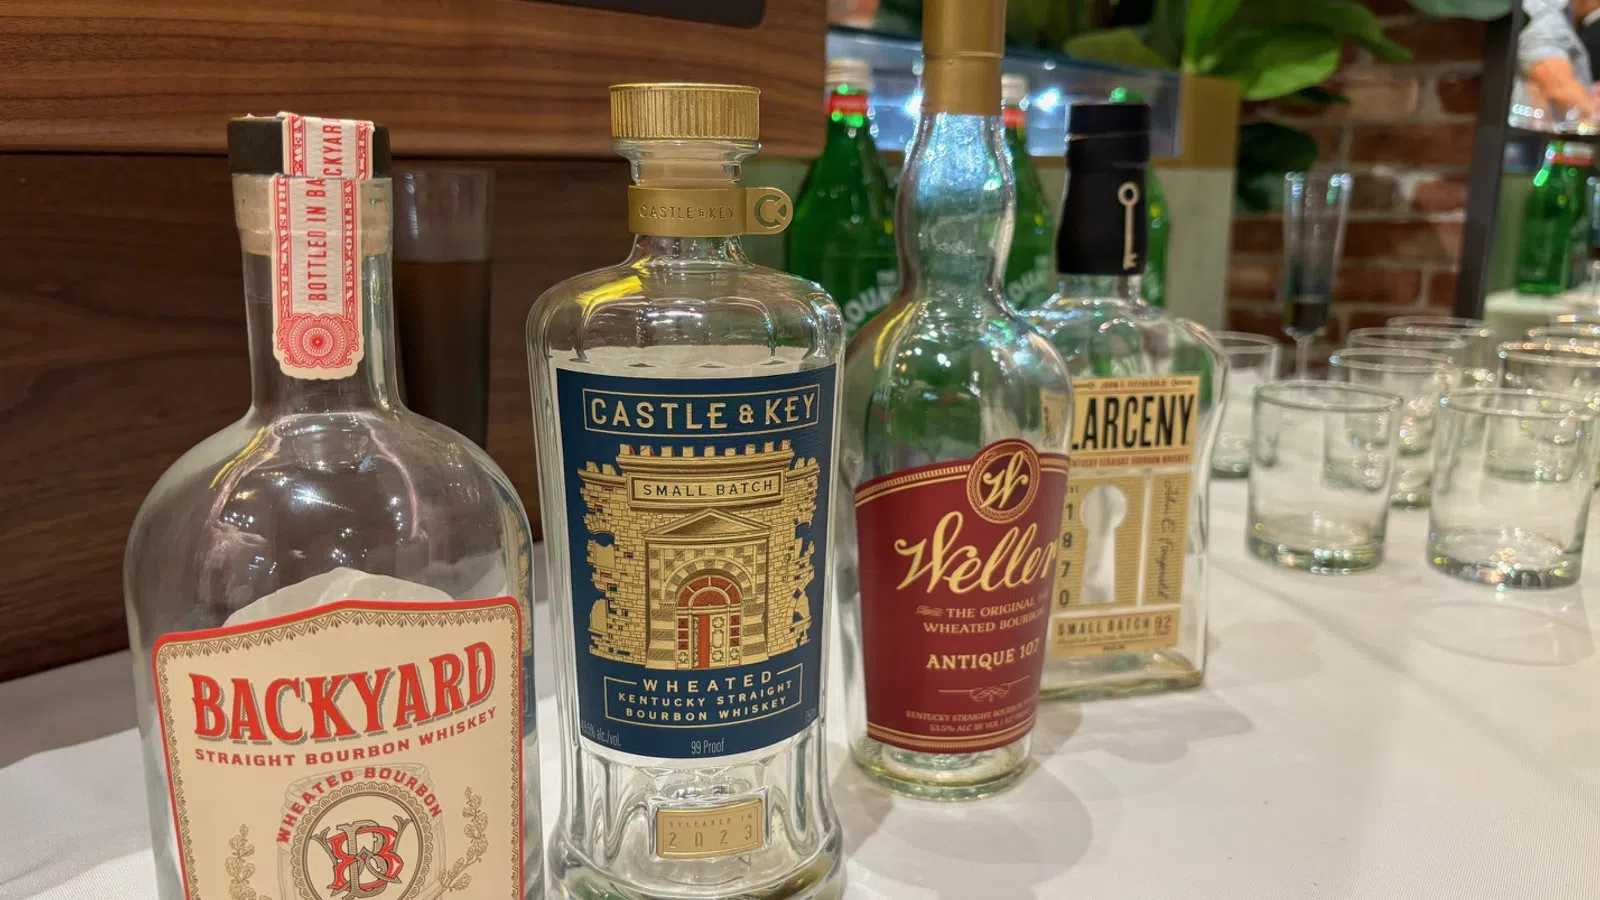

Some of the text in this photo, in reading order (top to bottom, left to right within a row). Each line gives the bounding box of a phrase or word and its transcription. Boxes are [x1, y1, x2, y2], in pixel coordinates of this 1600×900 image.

[306, 206, 327, 222] IN
[638, 205, 735, 219] CASTLE & KEY
[307, 230, 328, 301] BOTTLED
[591, 393, 815, 430] CASTLE & KEY
[1072, 394, 1194, 450] ARCENY
[643, 479, 773, 497] SMALL BATCH
[979, 451, 1029, 509] W
[894, 511, 1059, 594] Weller
[923, 606, 1046, 634] WHEATED BOURBON
[945, 597, 1036, 618] THE ORIGINAL
[1154, 613, 1172, 629] 92
[1057, 615, 1149, 637] SMALL BATCH
[926, 647, 1015, 671] ANTIQUE
[1019, 637, 1041, 659] 107
[188, 641, 497, 746] BACKYARD
[618, 679, 793, 707] KENTUCKY STRAIGHT
[642, 671, 772, 693] WHEATED
[625, 707, 707, 721] BOURBON
[718, 695, 787, 720] WHISKEY
[195, 706, 498, 767] STRAIGHT BOURBON WHISKEY
[691, 737, 725, 755] 99 Proof
[276, 766, 443, 844] WHEATED BOURBON
[740, 812, 753, 822] IN
[667, 824, 753, 849] 2023
